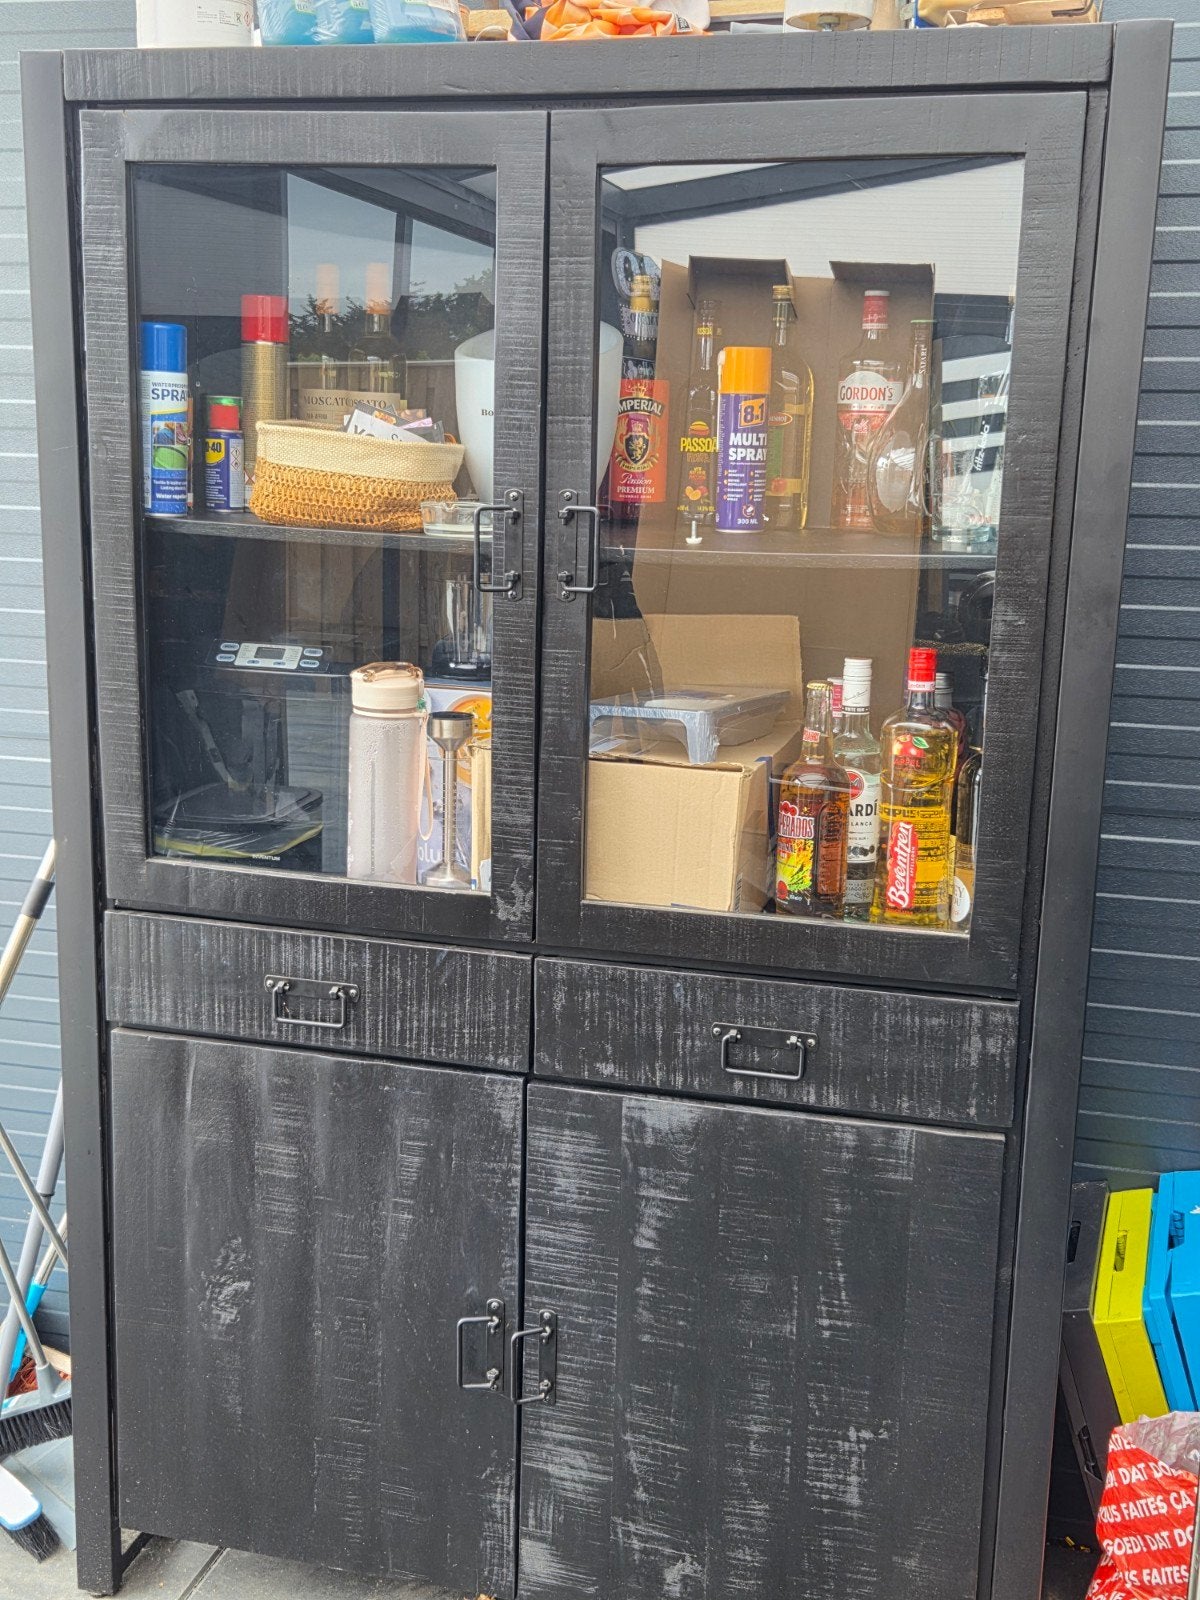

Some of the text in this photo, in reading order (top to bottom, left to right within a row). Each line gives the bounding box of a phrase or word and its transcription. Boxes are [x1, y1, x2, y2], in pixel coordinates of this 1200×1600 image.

[839, 385, 894, 402] GORDON'S
[619, 399, 662, 416] MPERIAL
[743, 402, 765, 424] 8.1
[728, 432, 768, 446] MULTI
[728, 446, 768, 461] SPRAY
[616, 486, 655, 494] PREMIUM
[1118, 1462, 1148, 1485] DAT
[1121, 1494, 1168, 1521] FAITES
[1169, 1490, 1196, 1515] ÇA
[1143, 1531, 1172, 1551] DAT
[1142, 1564, 1190, 1586] FAITES
